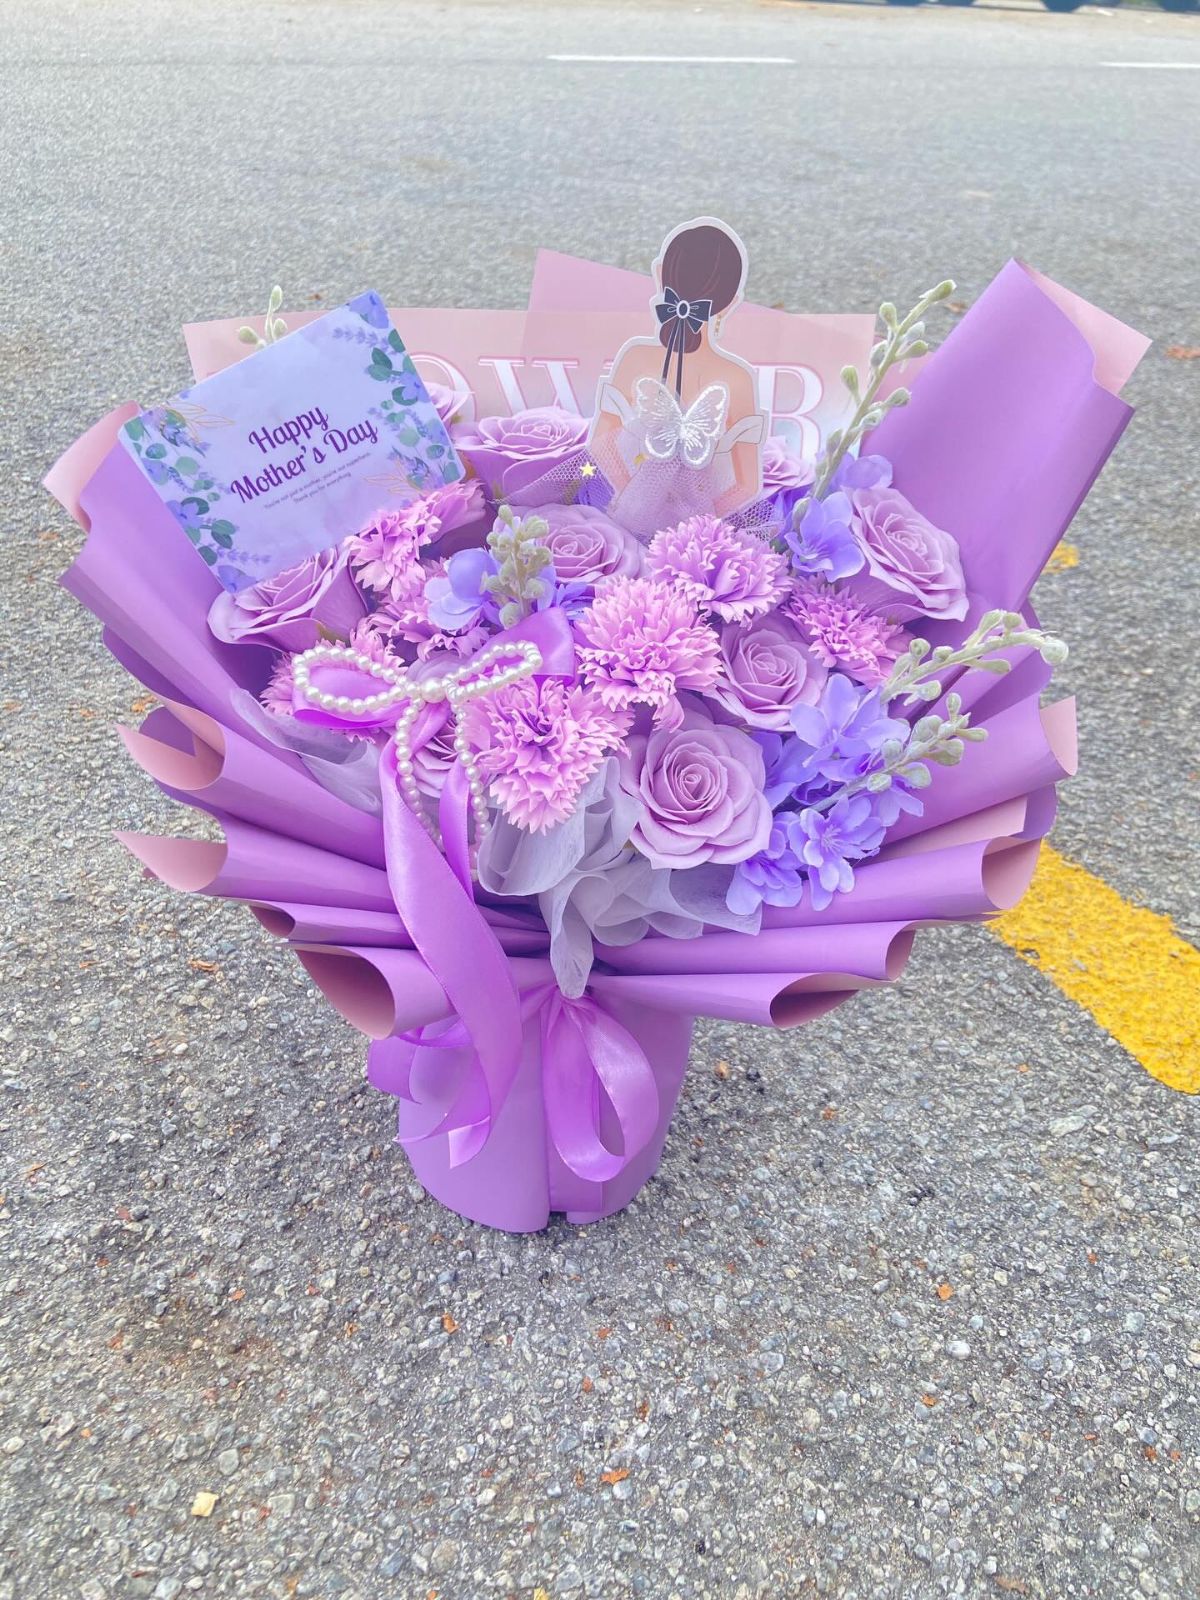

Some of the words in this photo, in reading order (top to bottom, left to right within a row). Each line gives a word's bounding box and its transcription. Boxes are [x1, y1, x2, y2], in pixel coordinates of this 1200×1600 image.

[230, 445, 326, 504] Mother’s
[323, 420, 378, 453] Day
[248, 407, 329, 454] Happy
